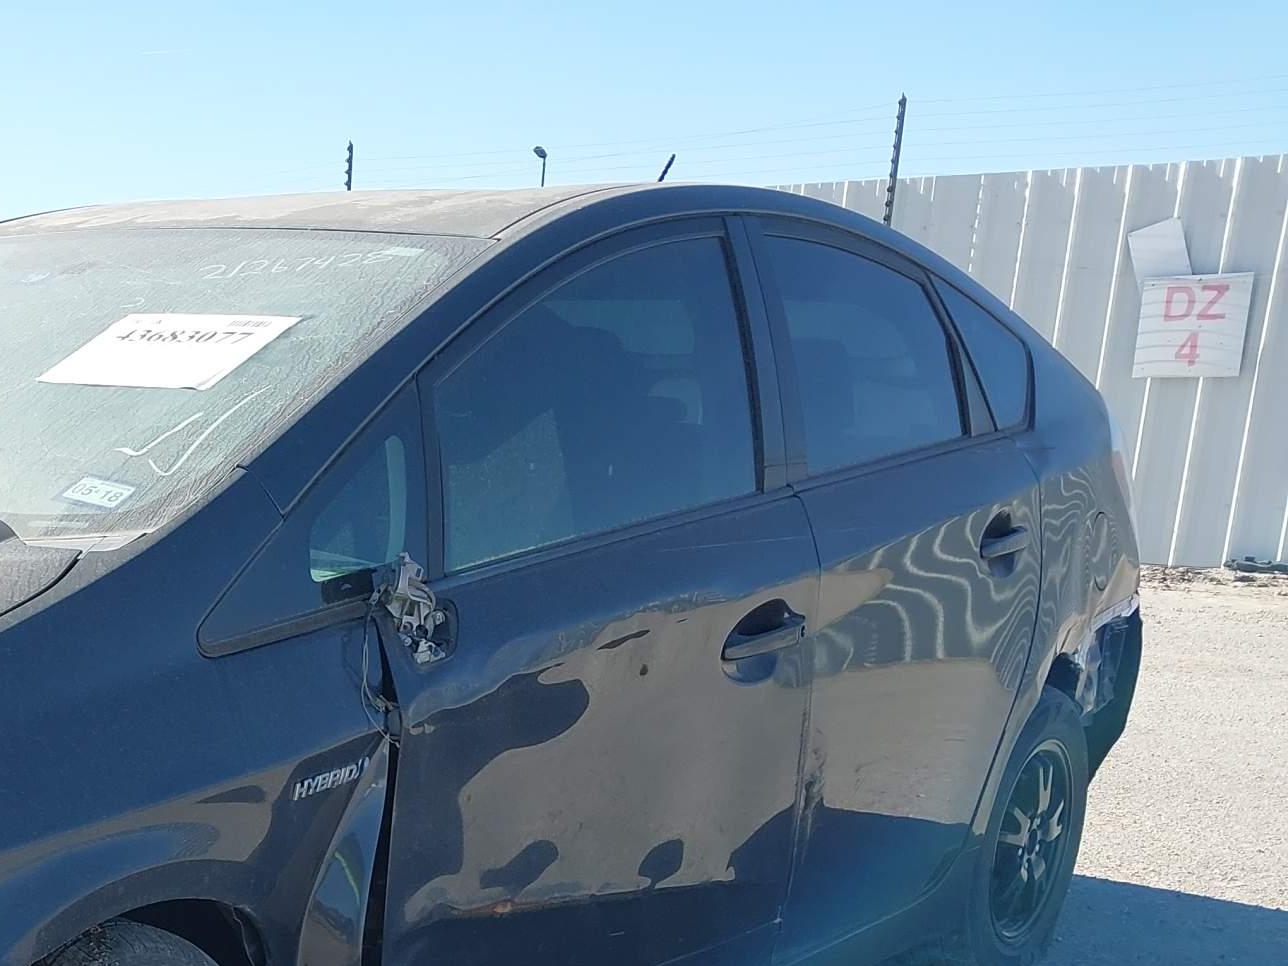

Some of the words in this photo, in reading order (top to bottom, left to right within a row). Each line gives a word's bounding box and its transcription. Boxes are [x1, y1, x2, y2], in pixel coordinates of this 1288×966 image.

[1163, 284, 1230, 322] DZ
[116, 329, 255, 345] 43683077
[1174, 331, 1201, 367] 4
[293, 765, 357, 801] HYBRID
